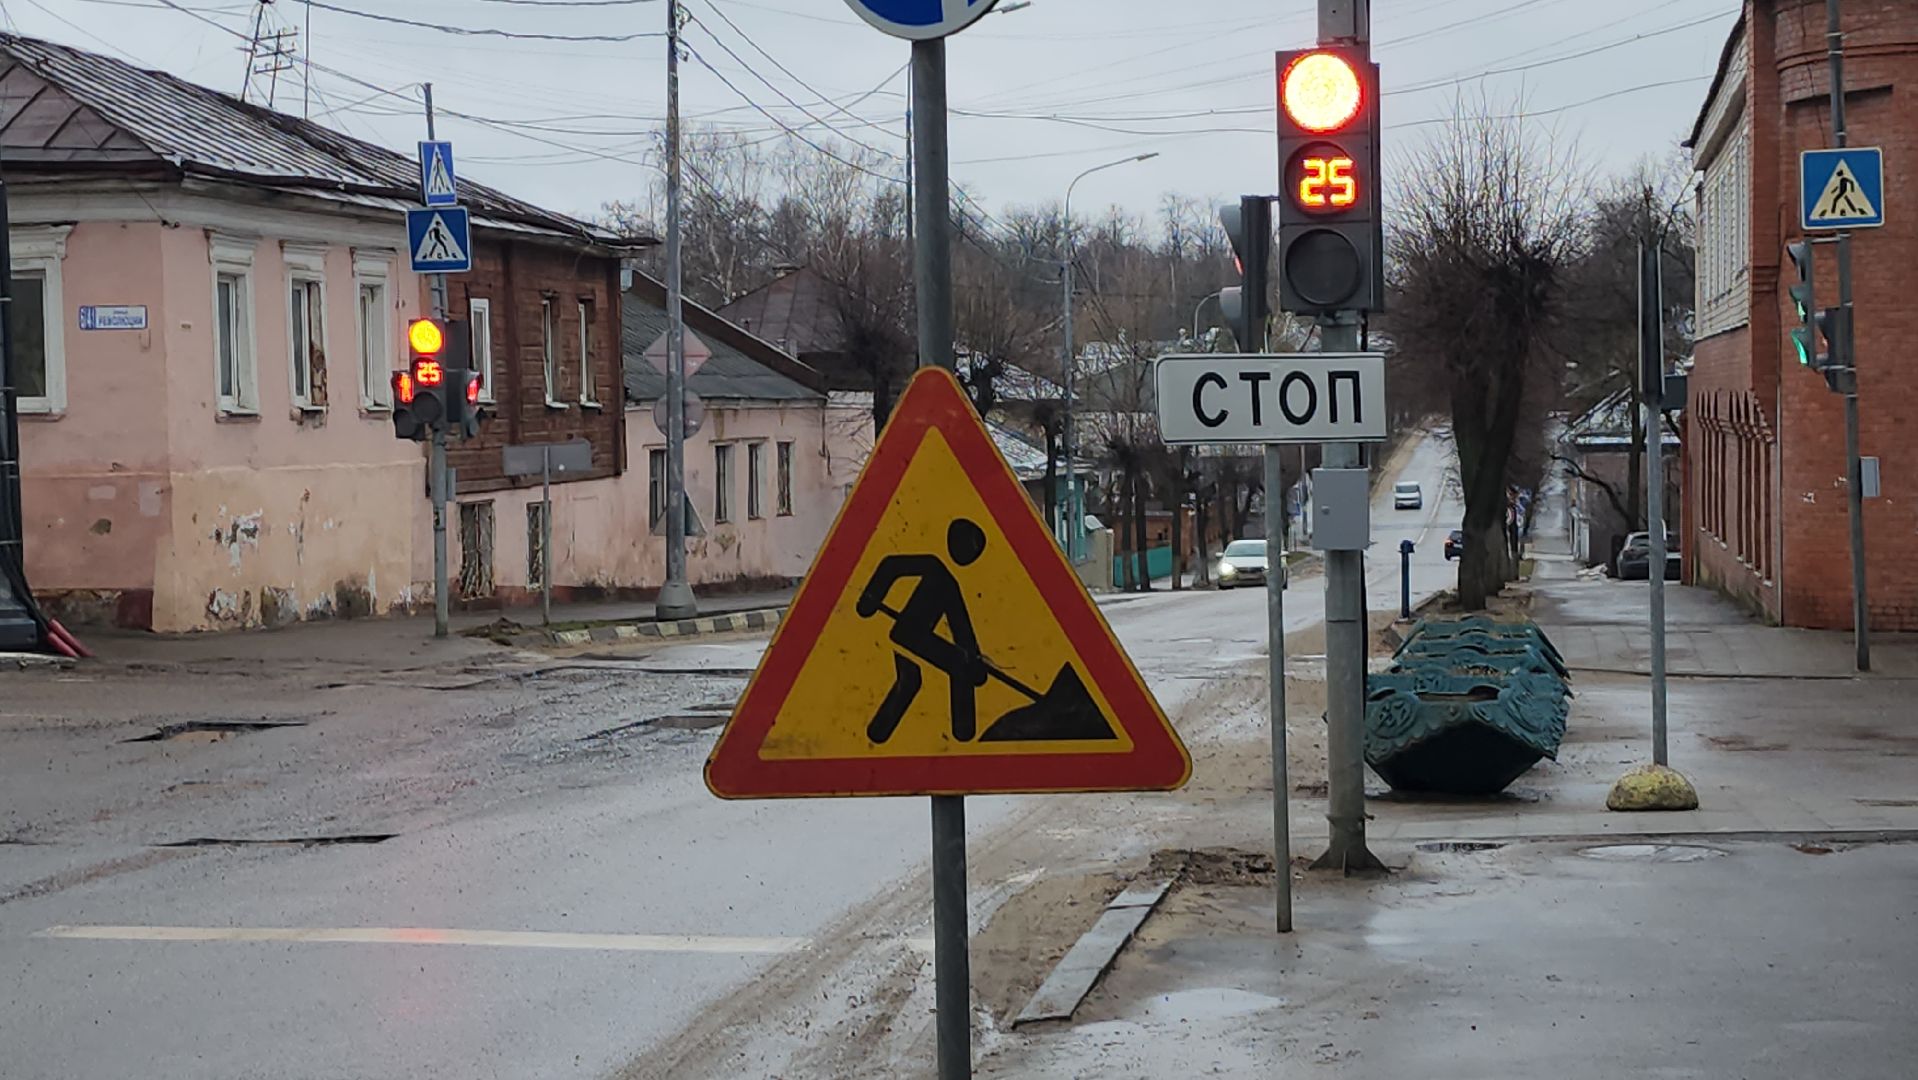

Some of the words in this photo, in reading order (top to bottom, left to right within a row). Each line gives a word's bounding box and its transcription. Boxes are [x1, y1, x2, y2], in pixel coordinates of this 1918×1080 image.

[1300, 158, 1355, 206] 25
[417, 362, 441, 383] 25
[1192, 370, 1362, 427] СТОП
